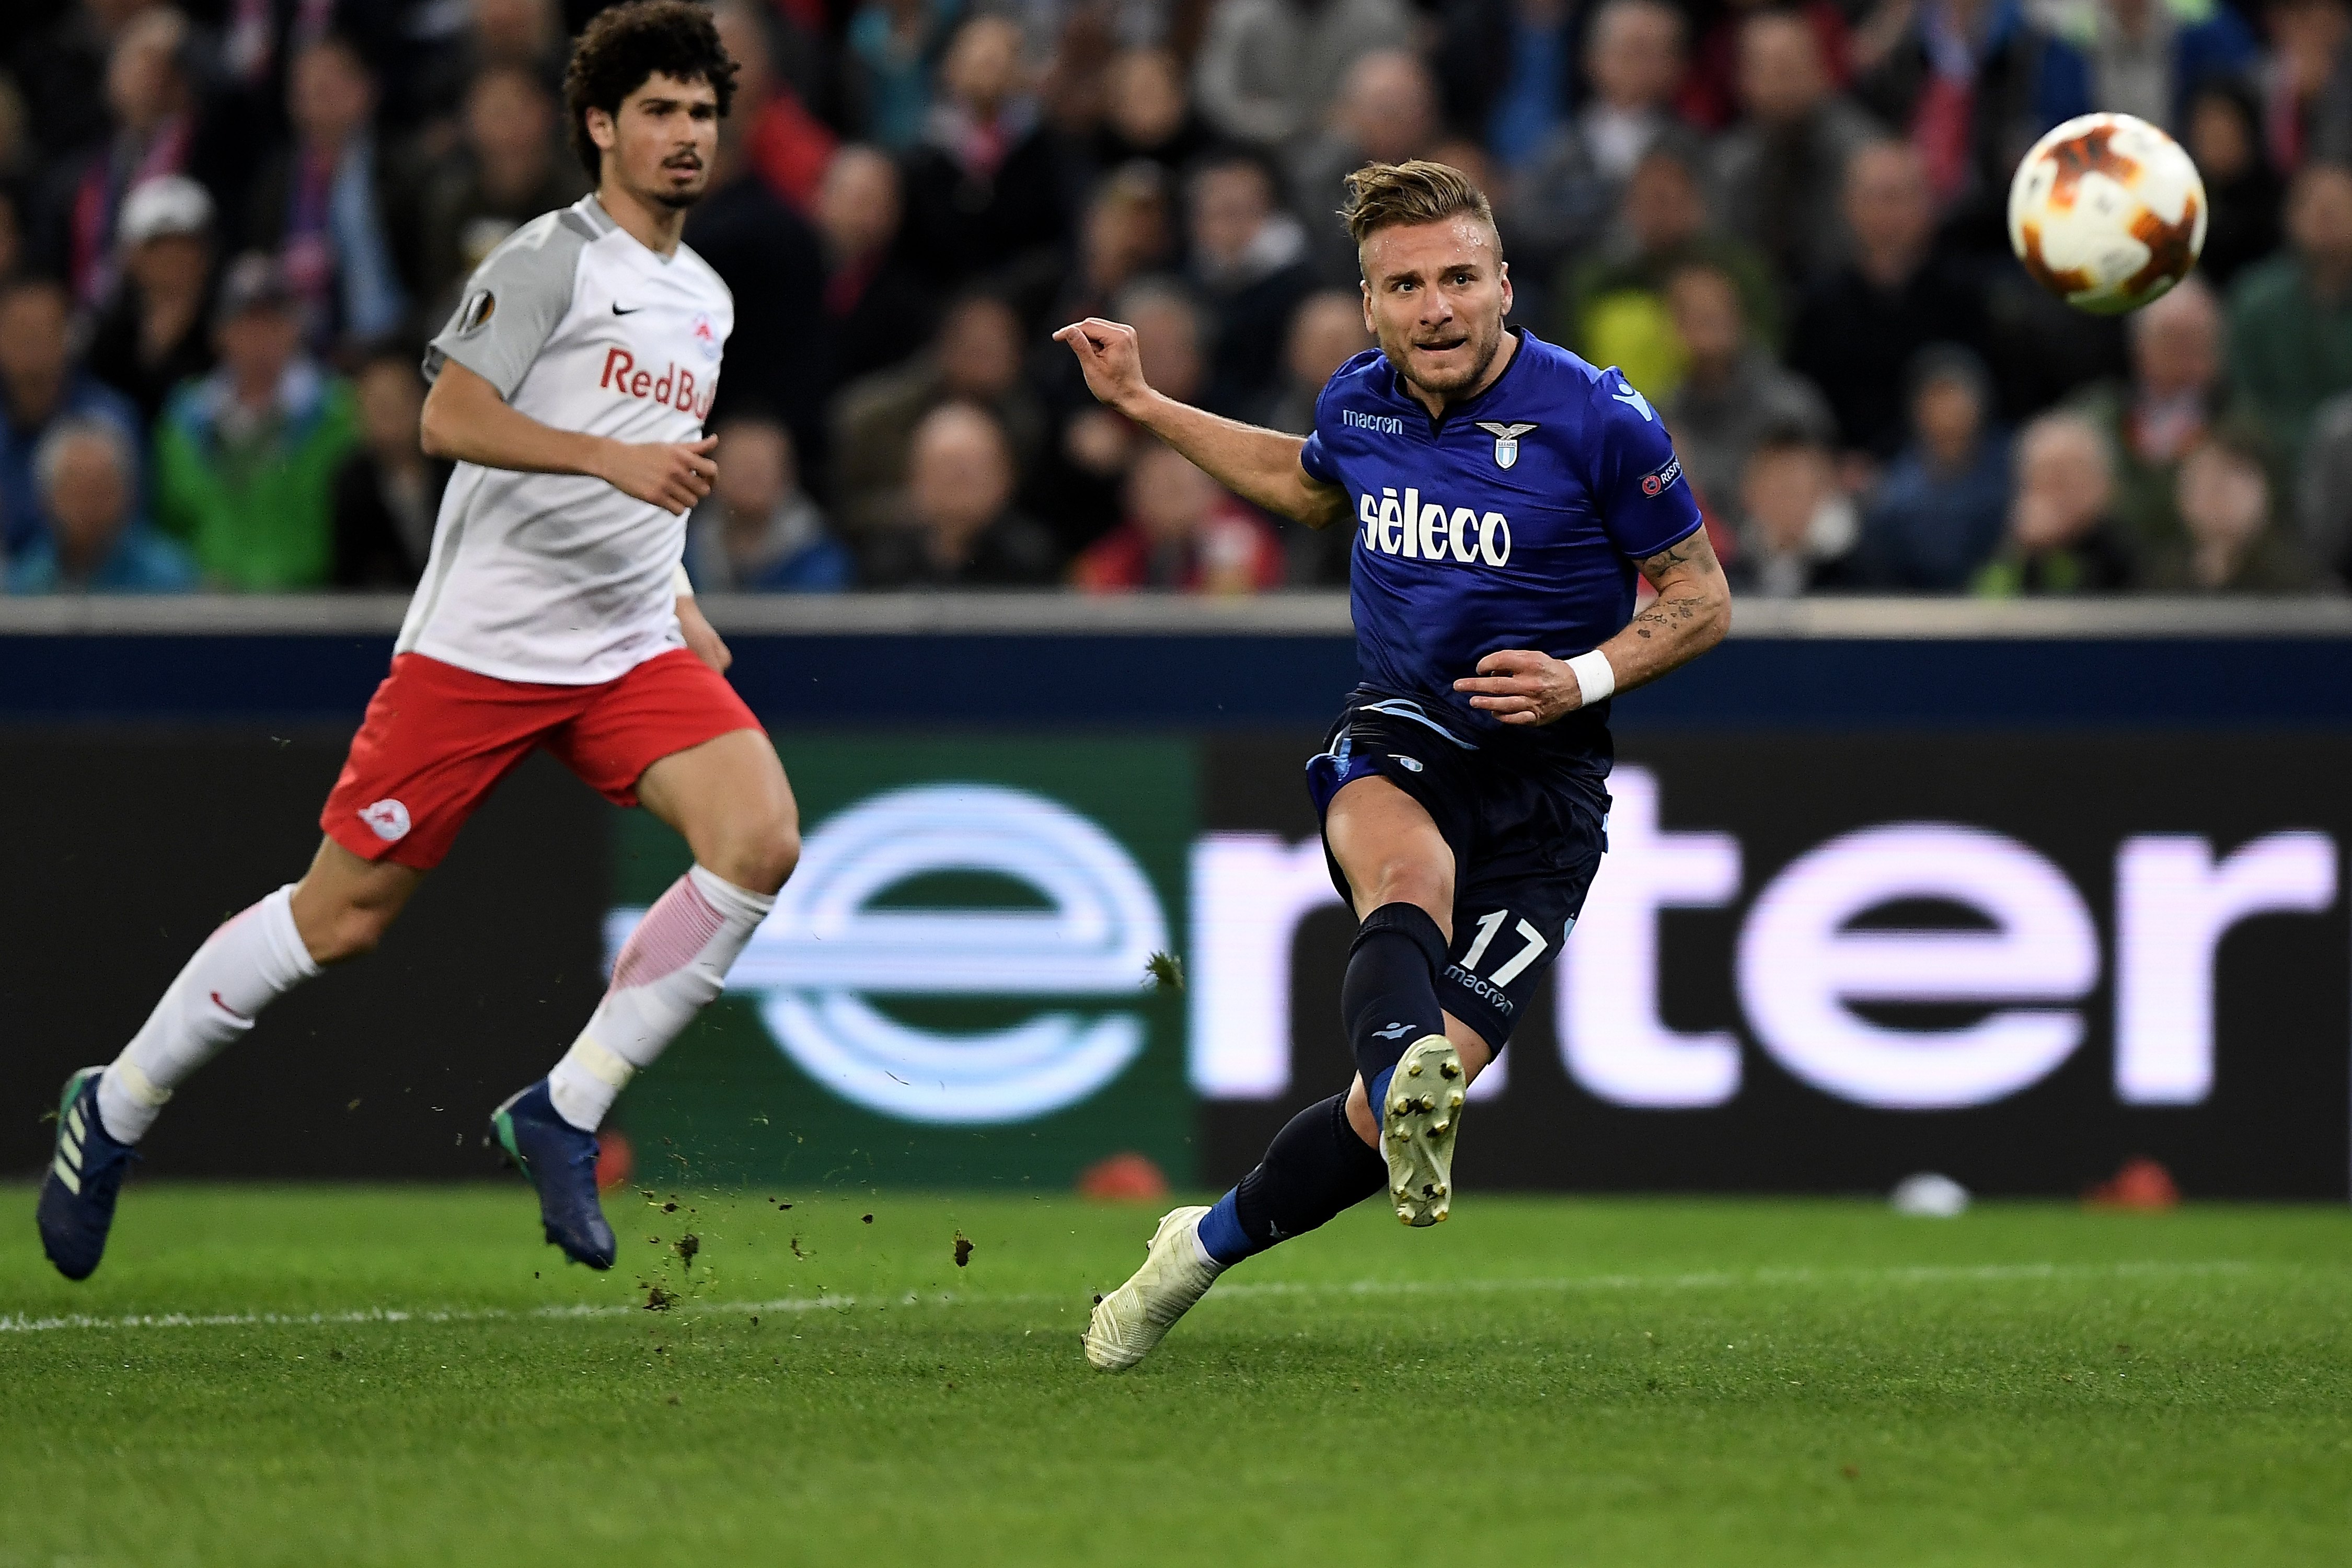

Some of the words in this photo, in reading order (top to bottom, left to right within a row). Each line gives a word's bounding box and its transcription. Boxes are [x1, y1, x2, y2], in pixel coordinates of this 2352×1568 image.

[601, 348, 674, 405] Red
[676, 368, 717, 419] Bul
[1343, 409, 1402, 435] macron
[1660, 455, 1680, 484] RESP
[604, 767, 2352, 1124] enter
[1459, 909, 1548, 988] 17
[1444, 964, 1514, 1017] macron
